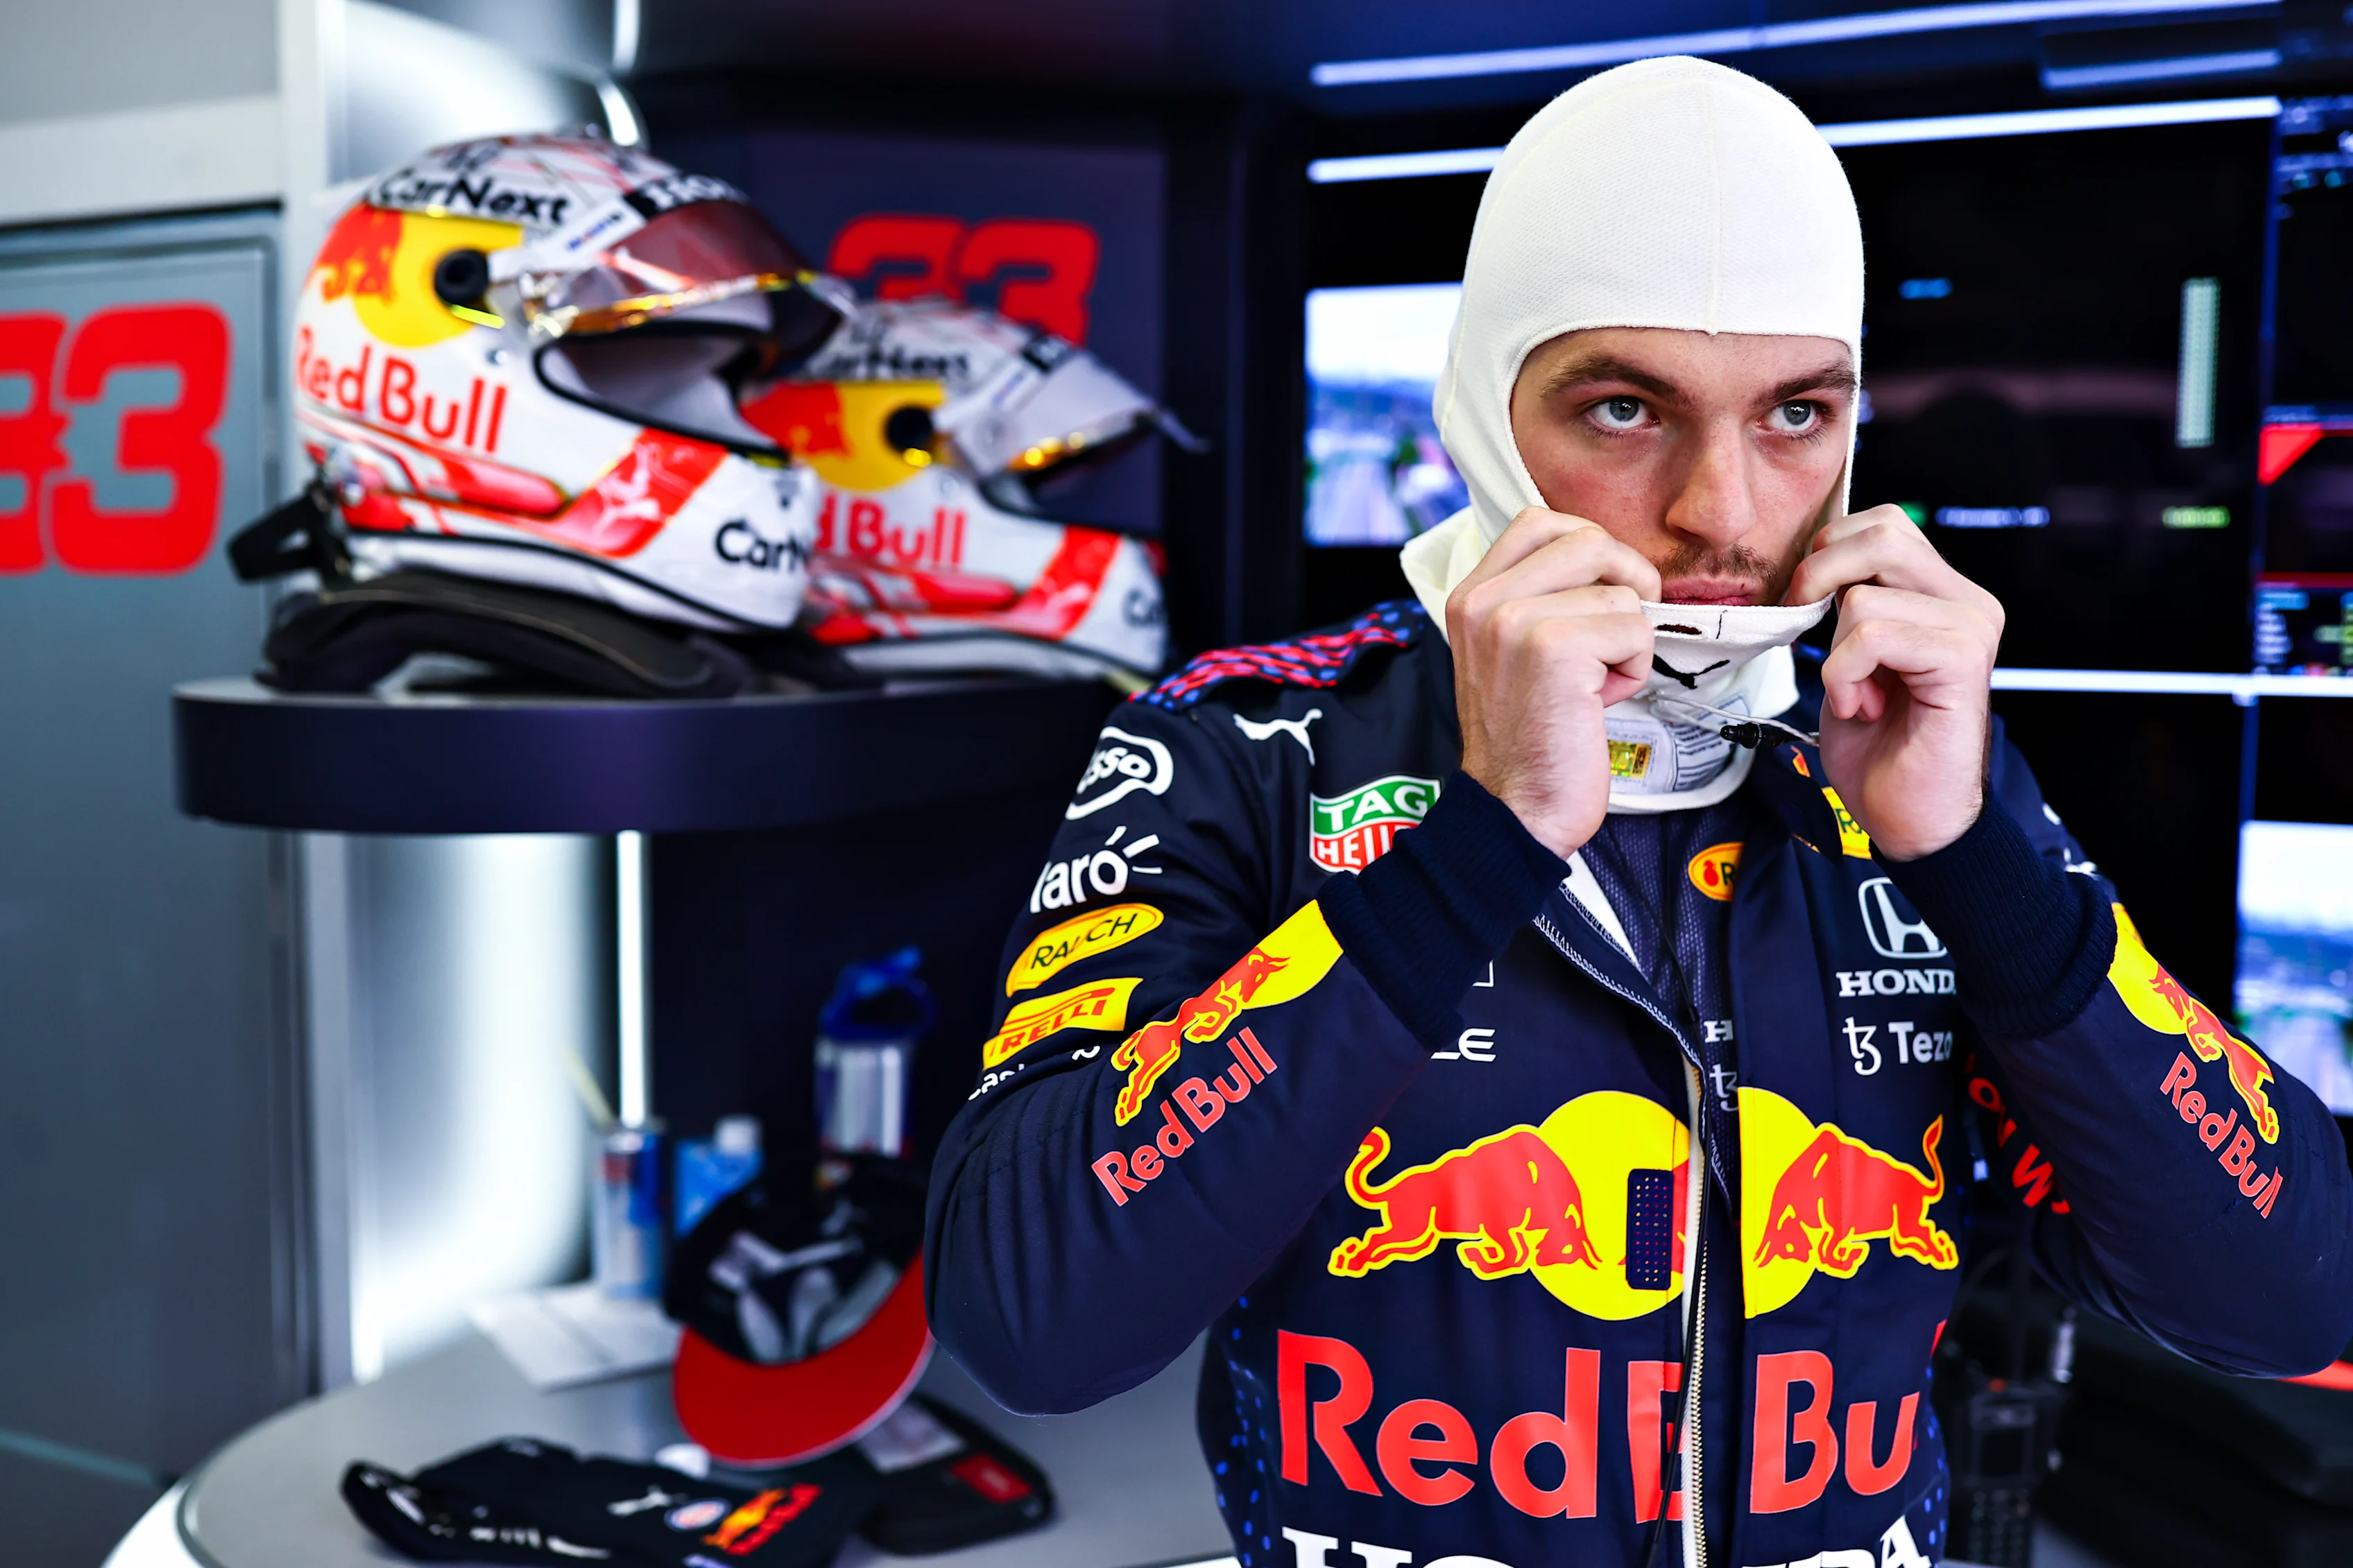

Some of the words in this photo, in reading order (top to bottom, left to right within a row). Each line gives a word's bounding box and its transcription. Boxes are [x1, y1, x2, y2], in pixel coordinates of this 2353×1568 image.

[379, 356, 506, 454] Bull
[847, 497, 967, 563] Bull
[1076, 746, 1152, 794] sso
[1317, 784, 1428, 832] TAG
[1317, 825, 1412, 867] HEU
[1836, 969, 1957, 997] HOND
[1091, 1100, 1195, 1207] Red
[1172, 1026, 1278, 1134] Bull
[2159, 1051, 2236, 1152] Red
[1277, 1329, 1601, 1519] Red
[1749, 1320, 1946, 1515] Bu
